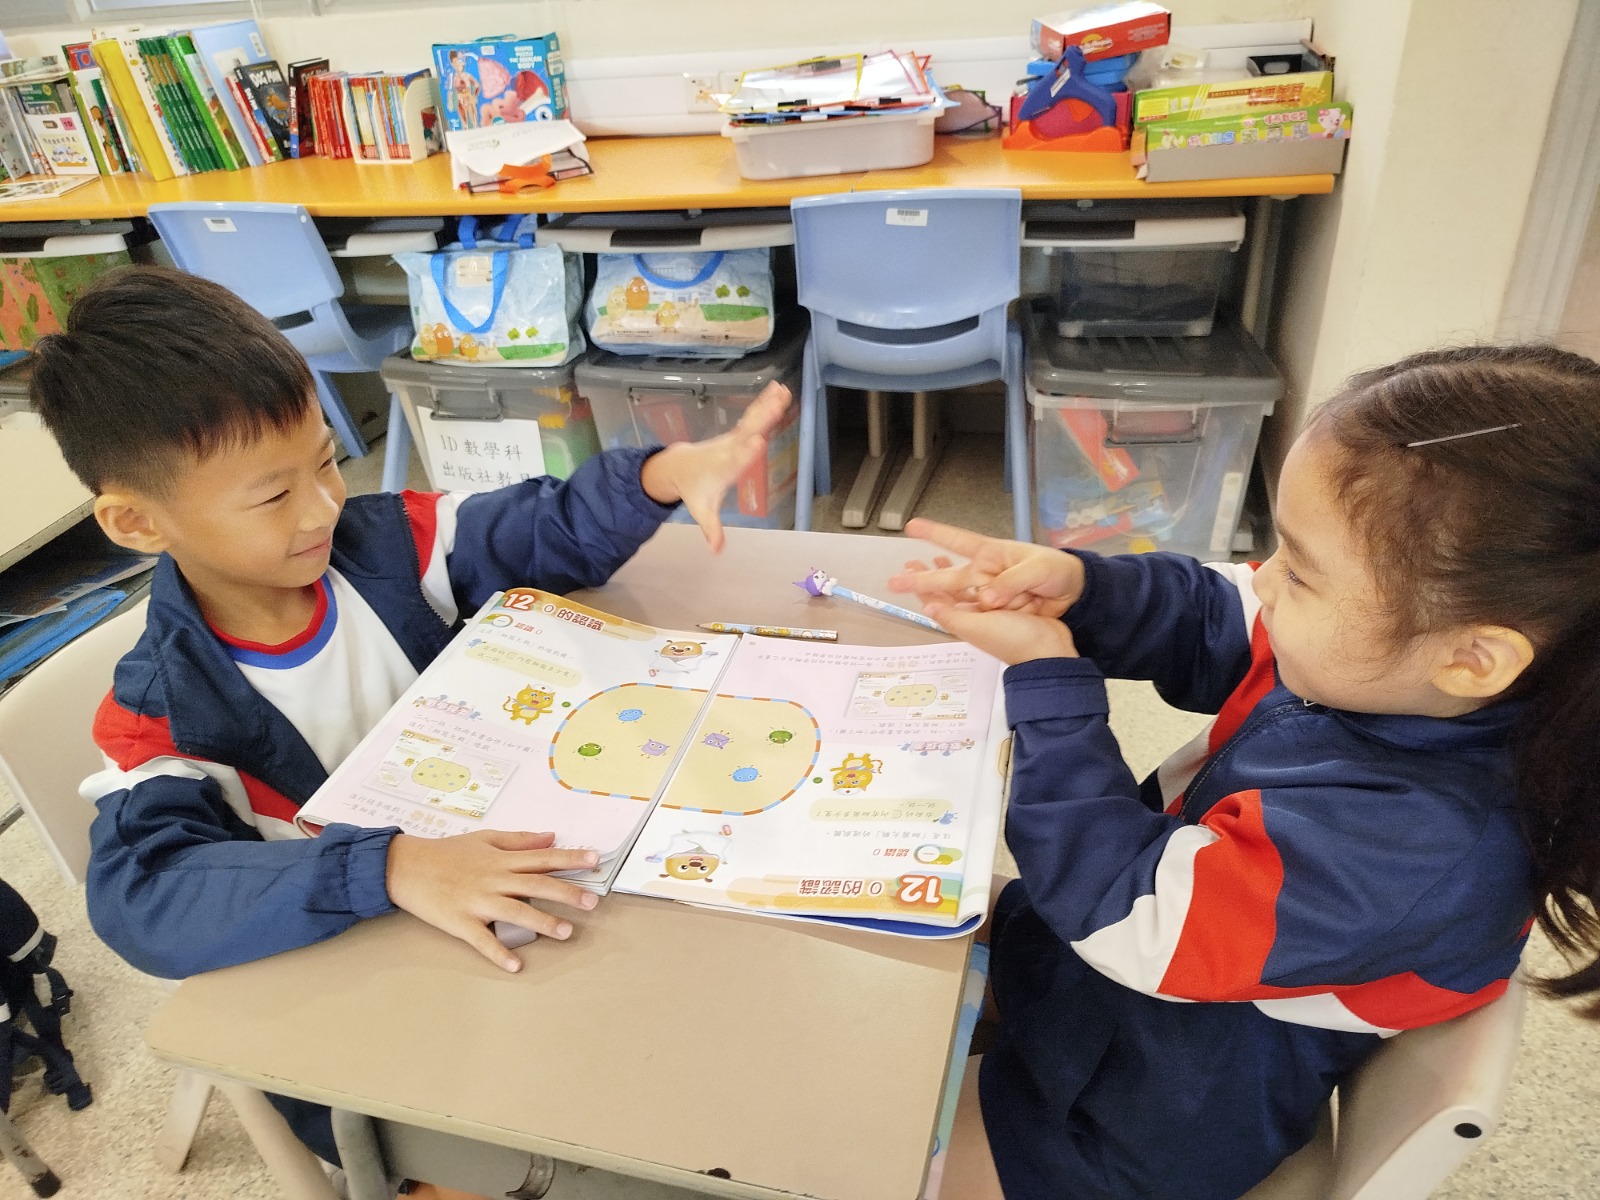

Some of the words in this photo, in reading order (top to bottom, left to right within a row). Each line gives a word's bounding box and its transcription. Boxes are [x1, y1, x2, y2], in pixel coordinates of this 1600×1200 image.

[464, 439, 522, 461] 數學科
[502, 591, 537, 613] 12
[557, 608, 604, 631] 的認識
[883, 848, 910, 857] 認識
[799, 879, 863, 896] 的認識
[901, 877, 941, 904] 12
